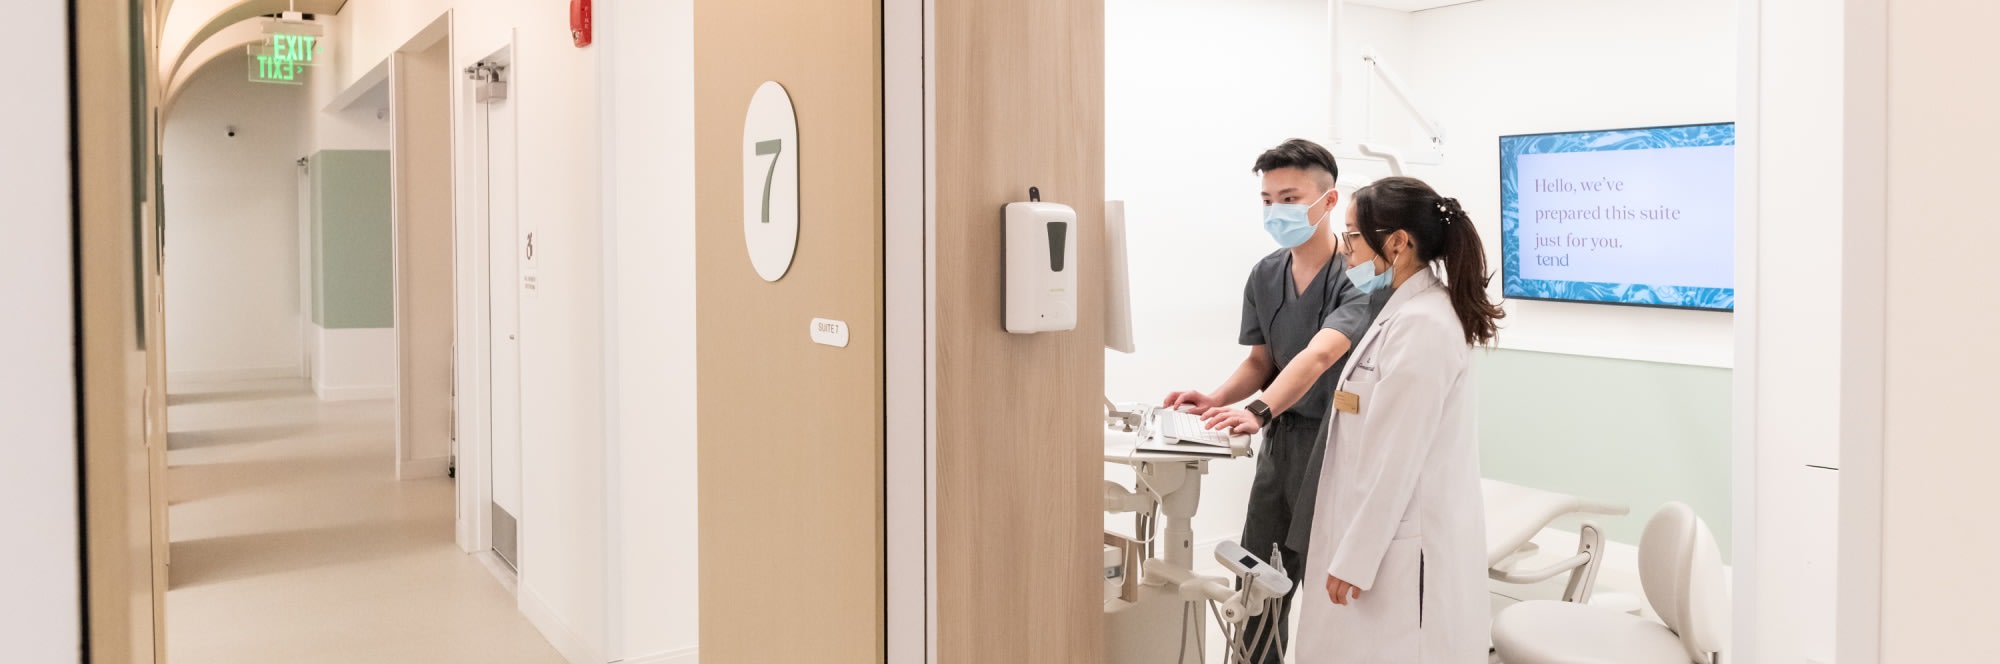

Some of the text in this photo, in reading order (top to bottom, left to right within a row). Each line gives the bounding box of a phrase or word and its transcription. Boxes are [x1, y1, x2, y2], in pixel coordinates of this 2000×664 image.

[273, 34, 315, 62] EXIT
[755, 138, 782, 223] 7
[1534, 177, 1577, 194] Hello,
[1535, 205, 1681, 224] prepared this suite
[1534, 232, 1624, 251] just for you.
[1536, 253, 1570, 267] tend
[818, 322, 840, 334] SUITE 7
